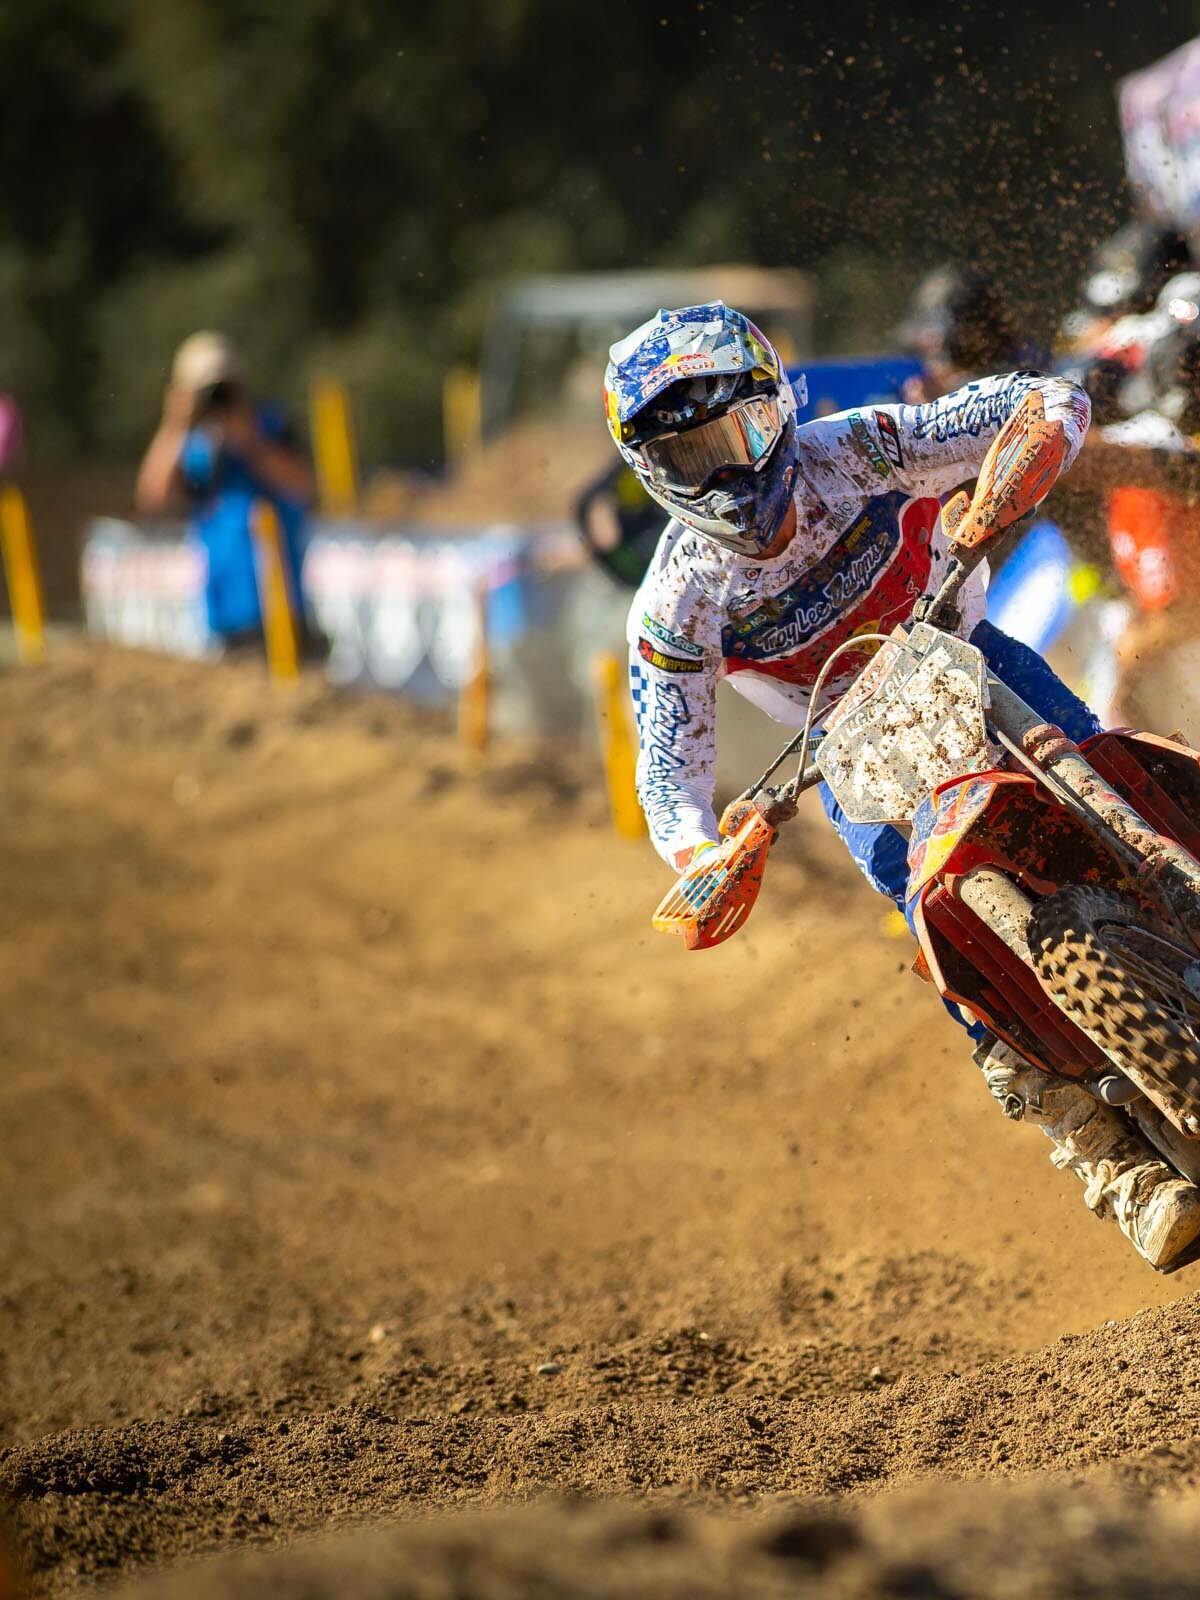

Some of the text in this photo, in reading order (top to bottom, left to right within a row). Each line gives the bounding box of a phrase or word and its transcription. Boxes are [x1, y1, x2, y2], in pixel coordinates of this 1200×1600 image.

[647, 618, 701, 656] MOTOREX
[757, 617, 799, 653] Troy
[795, 600, 832, 633] Lee
